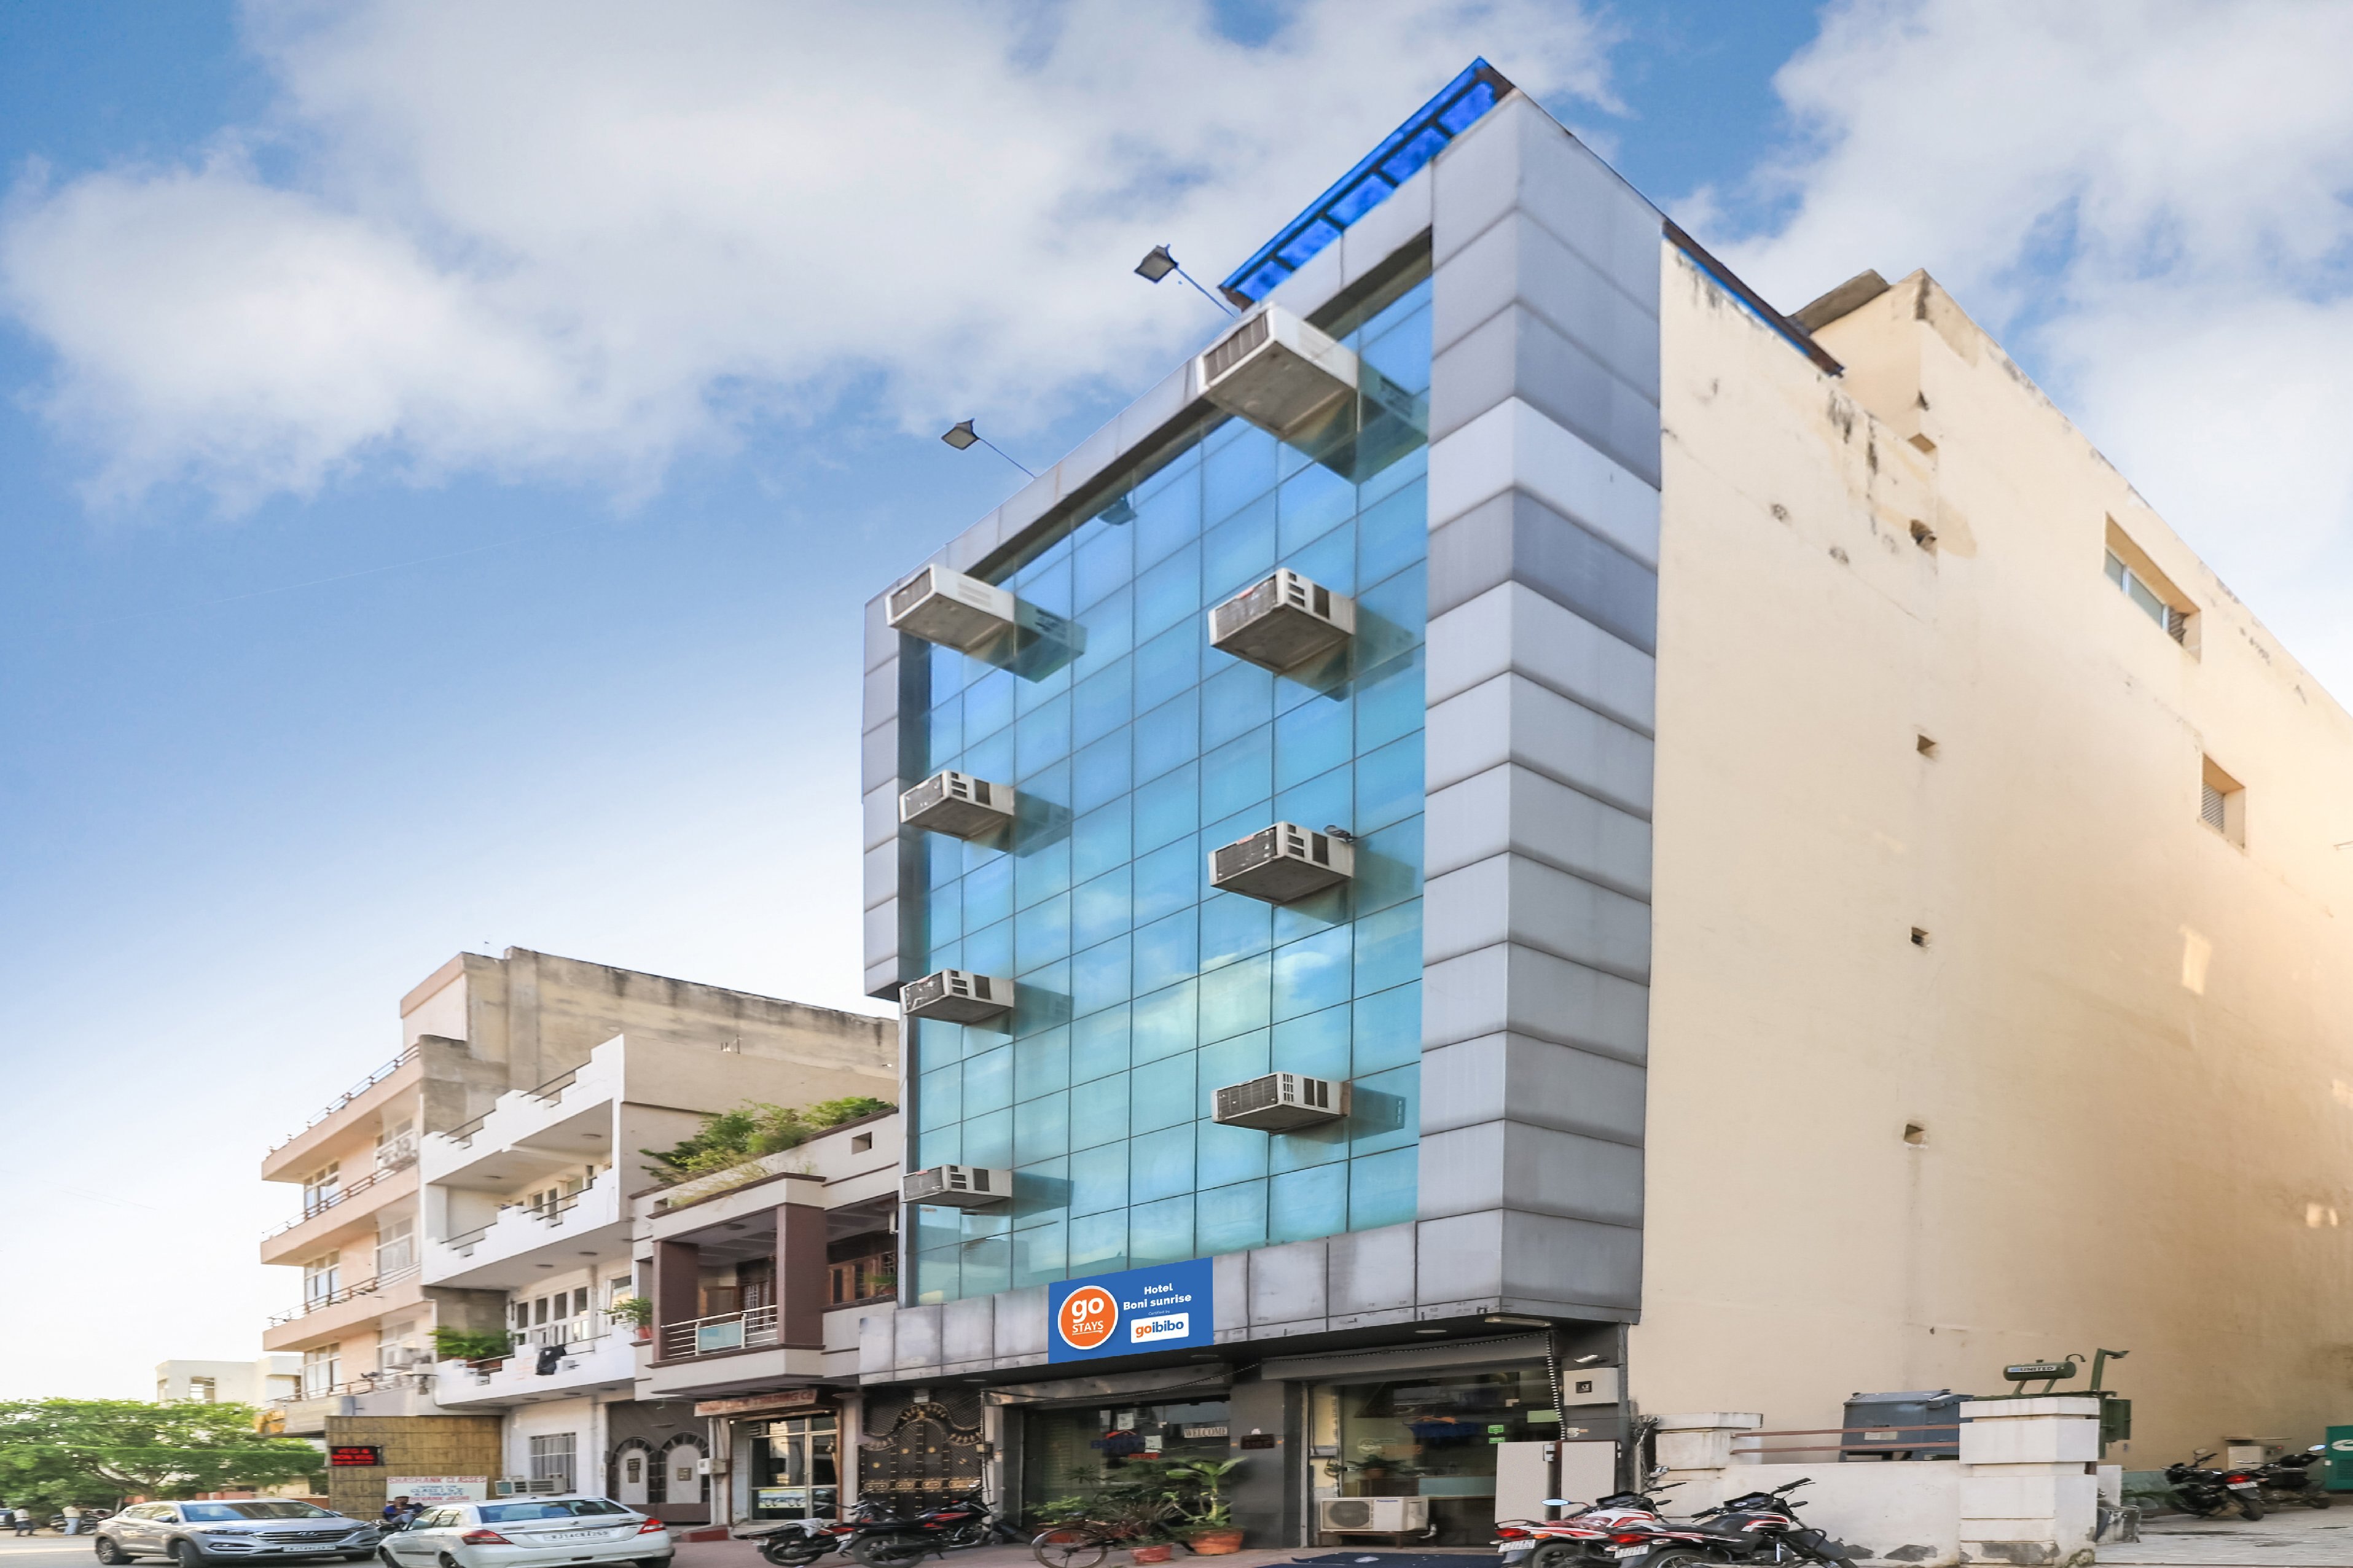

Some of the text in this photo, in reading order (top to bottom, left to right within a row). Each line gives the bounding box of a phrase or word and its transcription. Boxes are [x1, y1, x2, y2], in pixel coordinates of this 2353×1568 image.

[1144, 1283, 1173, 1295] Hotel
[1123, 1294, 1192, 1310] Boni sunrise
[1071, 1297, 1104, 1323] go
[1072, 1320, 1104, 1333] STAYS
[1136, 1320, 1184, 1338] goibibo
[1184, 1427, 1226, 1437] WELCOME
